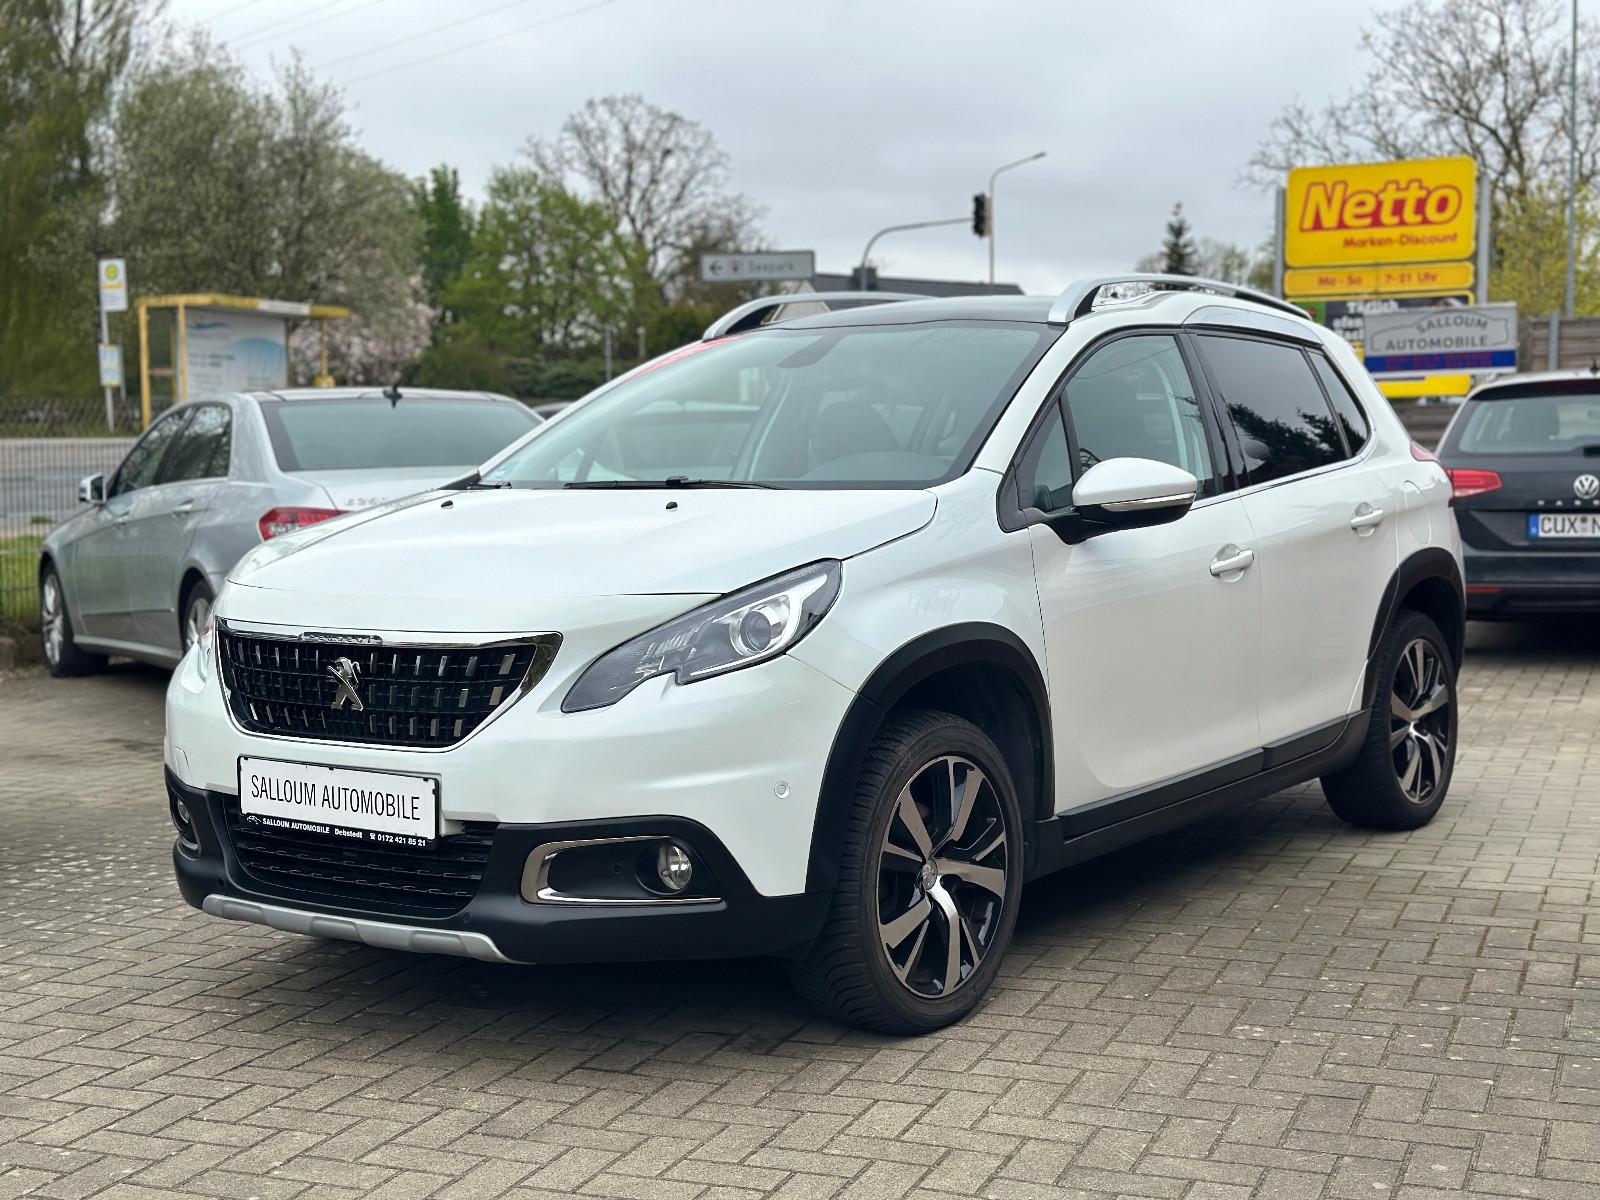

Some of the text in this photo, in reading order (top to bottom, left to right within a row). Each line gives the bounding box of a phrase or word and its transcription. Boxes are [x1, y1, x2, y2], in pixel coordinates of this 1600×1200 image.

[1300, 179, 1462, 232] Netto
[1416, 315, 1489, 335] SALLOUM
[1385, 336, 1488, 351] AUTOMOBILE
[1541, 516, 1578, 533] CUX
[251, 774, 421, 821] SALLOUM AUTOMOBILE
[262, 817, 290, 829] SALLOUM
[291, 822, 330, 834] AUTOMOBILE
[377, 834, 394, 843] 0172
[395, 837, 406, 845] 421
